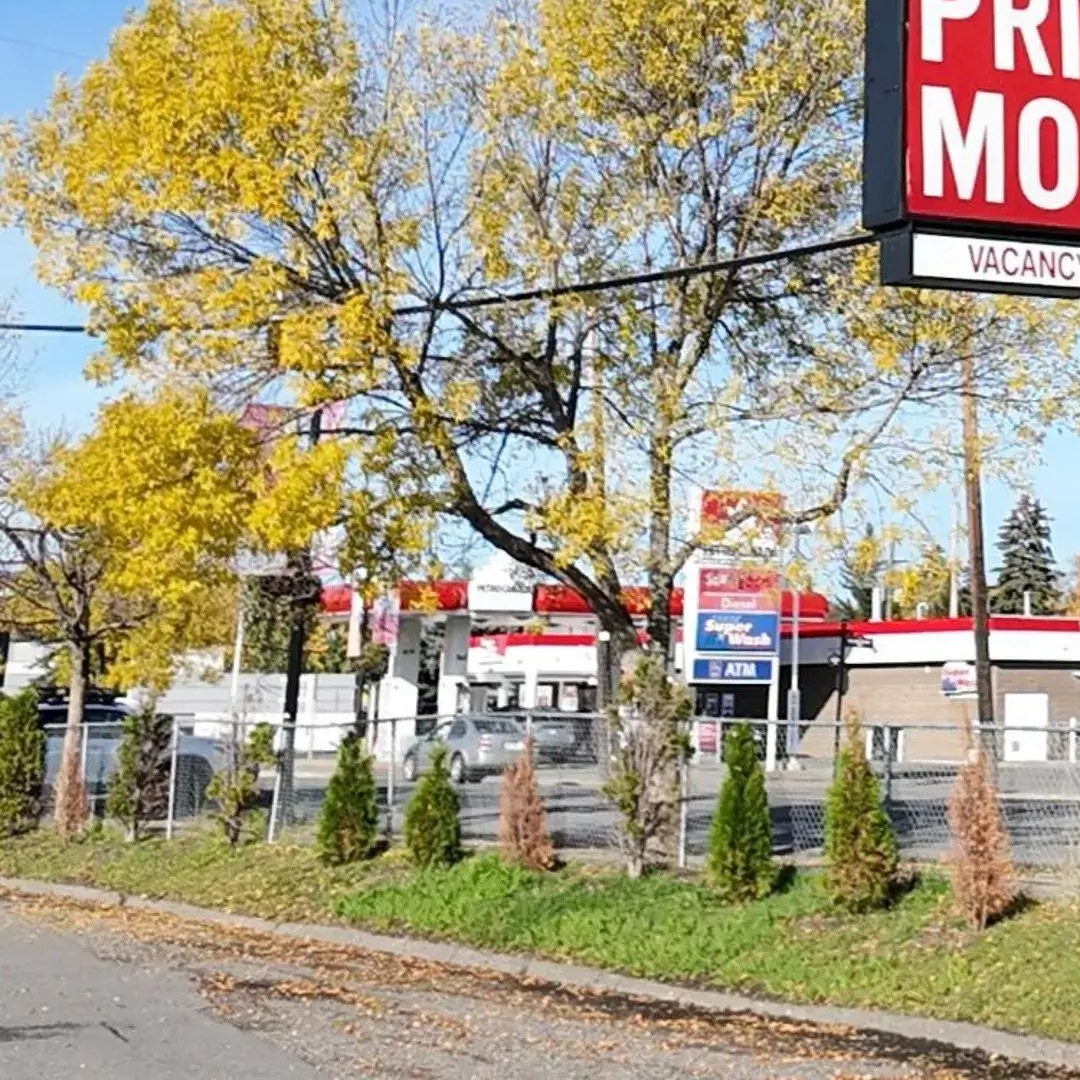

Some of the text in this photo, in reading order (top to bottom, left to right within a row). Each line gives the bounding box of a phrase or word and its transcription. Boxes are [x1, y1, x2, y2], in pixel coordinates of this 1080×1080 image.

[704, 619, 753, 635] Super
[726, 631, 772, 646] Wash
[724, 662, 757, 678] ATM
